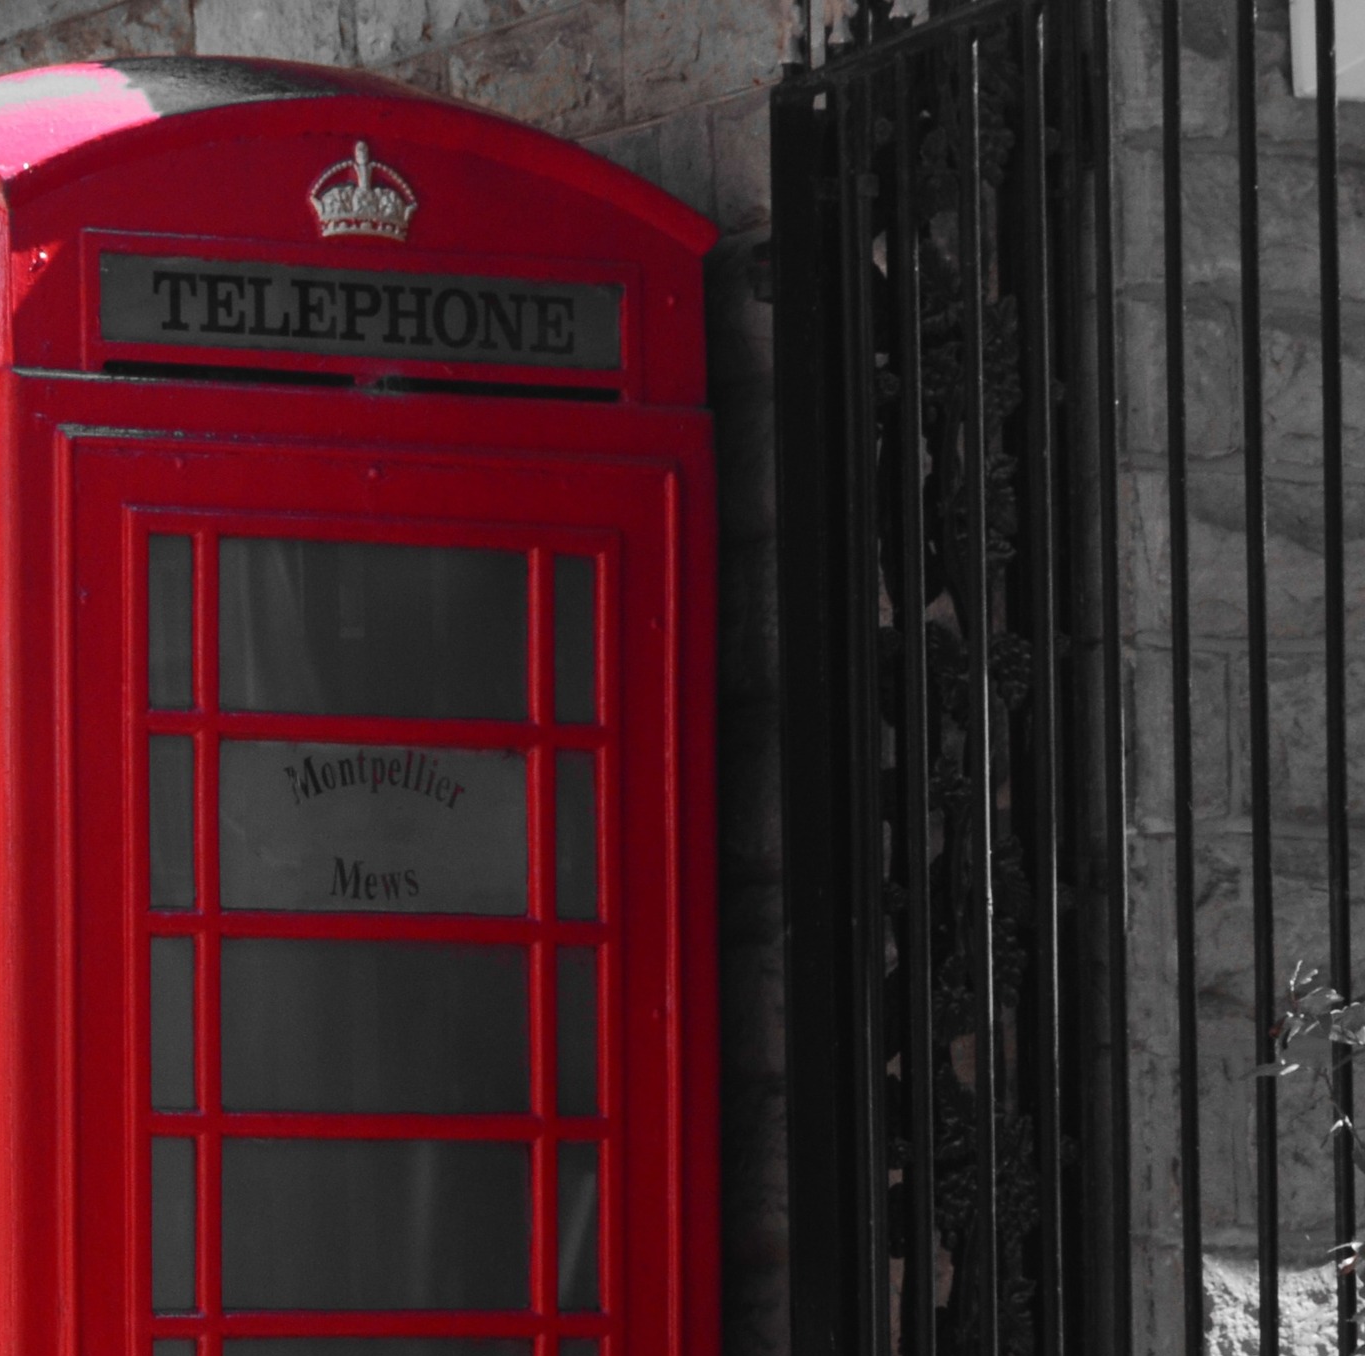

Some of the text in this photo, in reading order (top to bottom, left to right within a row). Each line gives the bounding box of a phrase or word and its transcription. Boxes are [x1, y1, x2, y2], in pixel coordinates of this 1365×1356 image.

[151, 269, 575, 356] TELEPHONE
[283, 750, 466, 810] Montpellier
[329, 856, 420, 900] Mews
